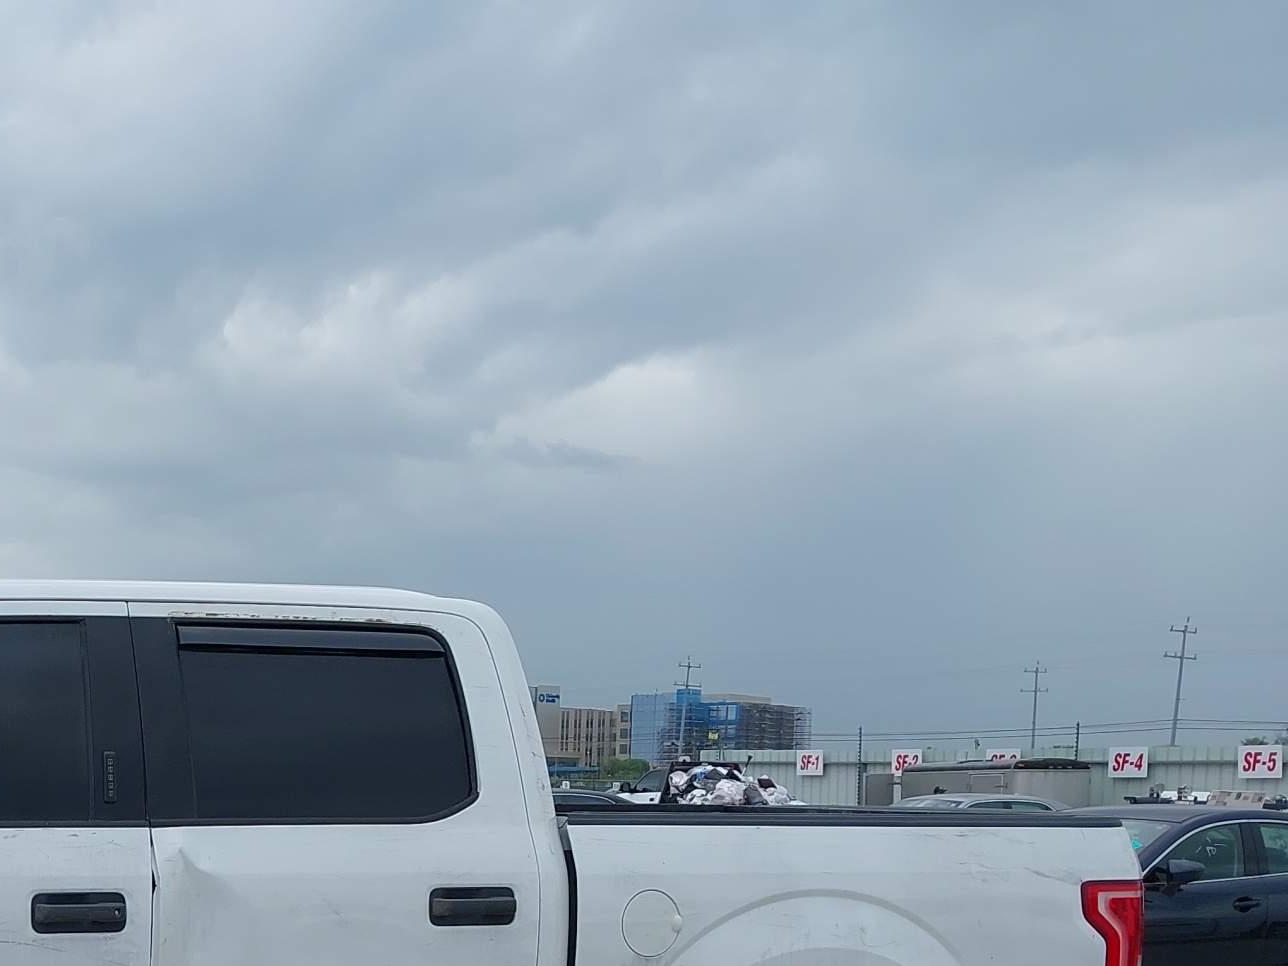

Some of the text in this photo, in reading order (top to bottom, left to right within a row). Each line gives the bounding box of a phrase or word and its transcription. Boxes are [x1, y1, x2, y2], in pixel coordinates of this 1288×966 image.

[800, 754, 820, 771] SF-1
[1112, 752, 1144, 773] SF-4
[1242, 751, 1278, 773] SF-5
